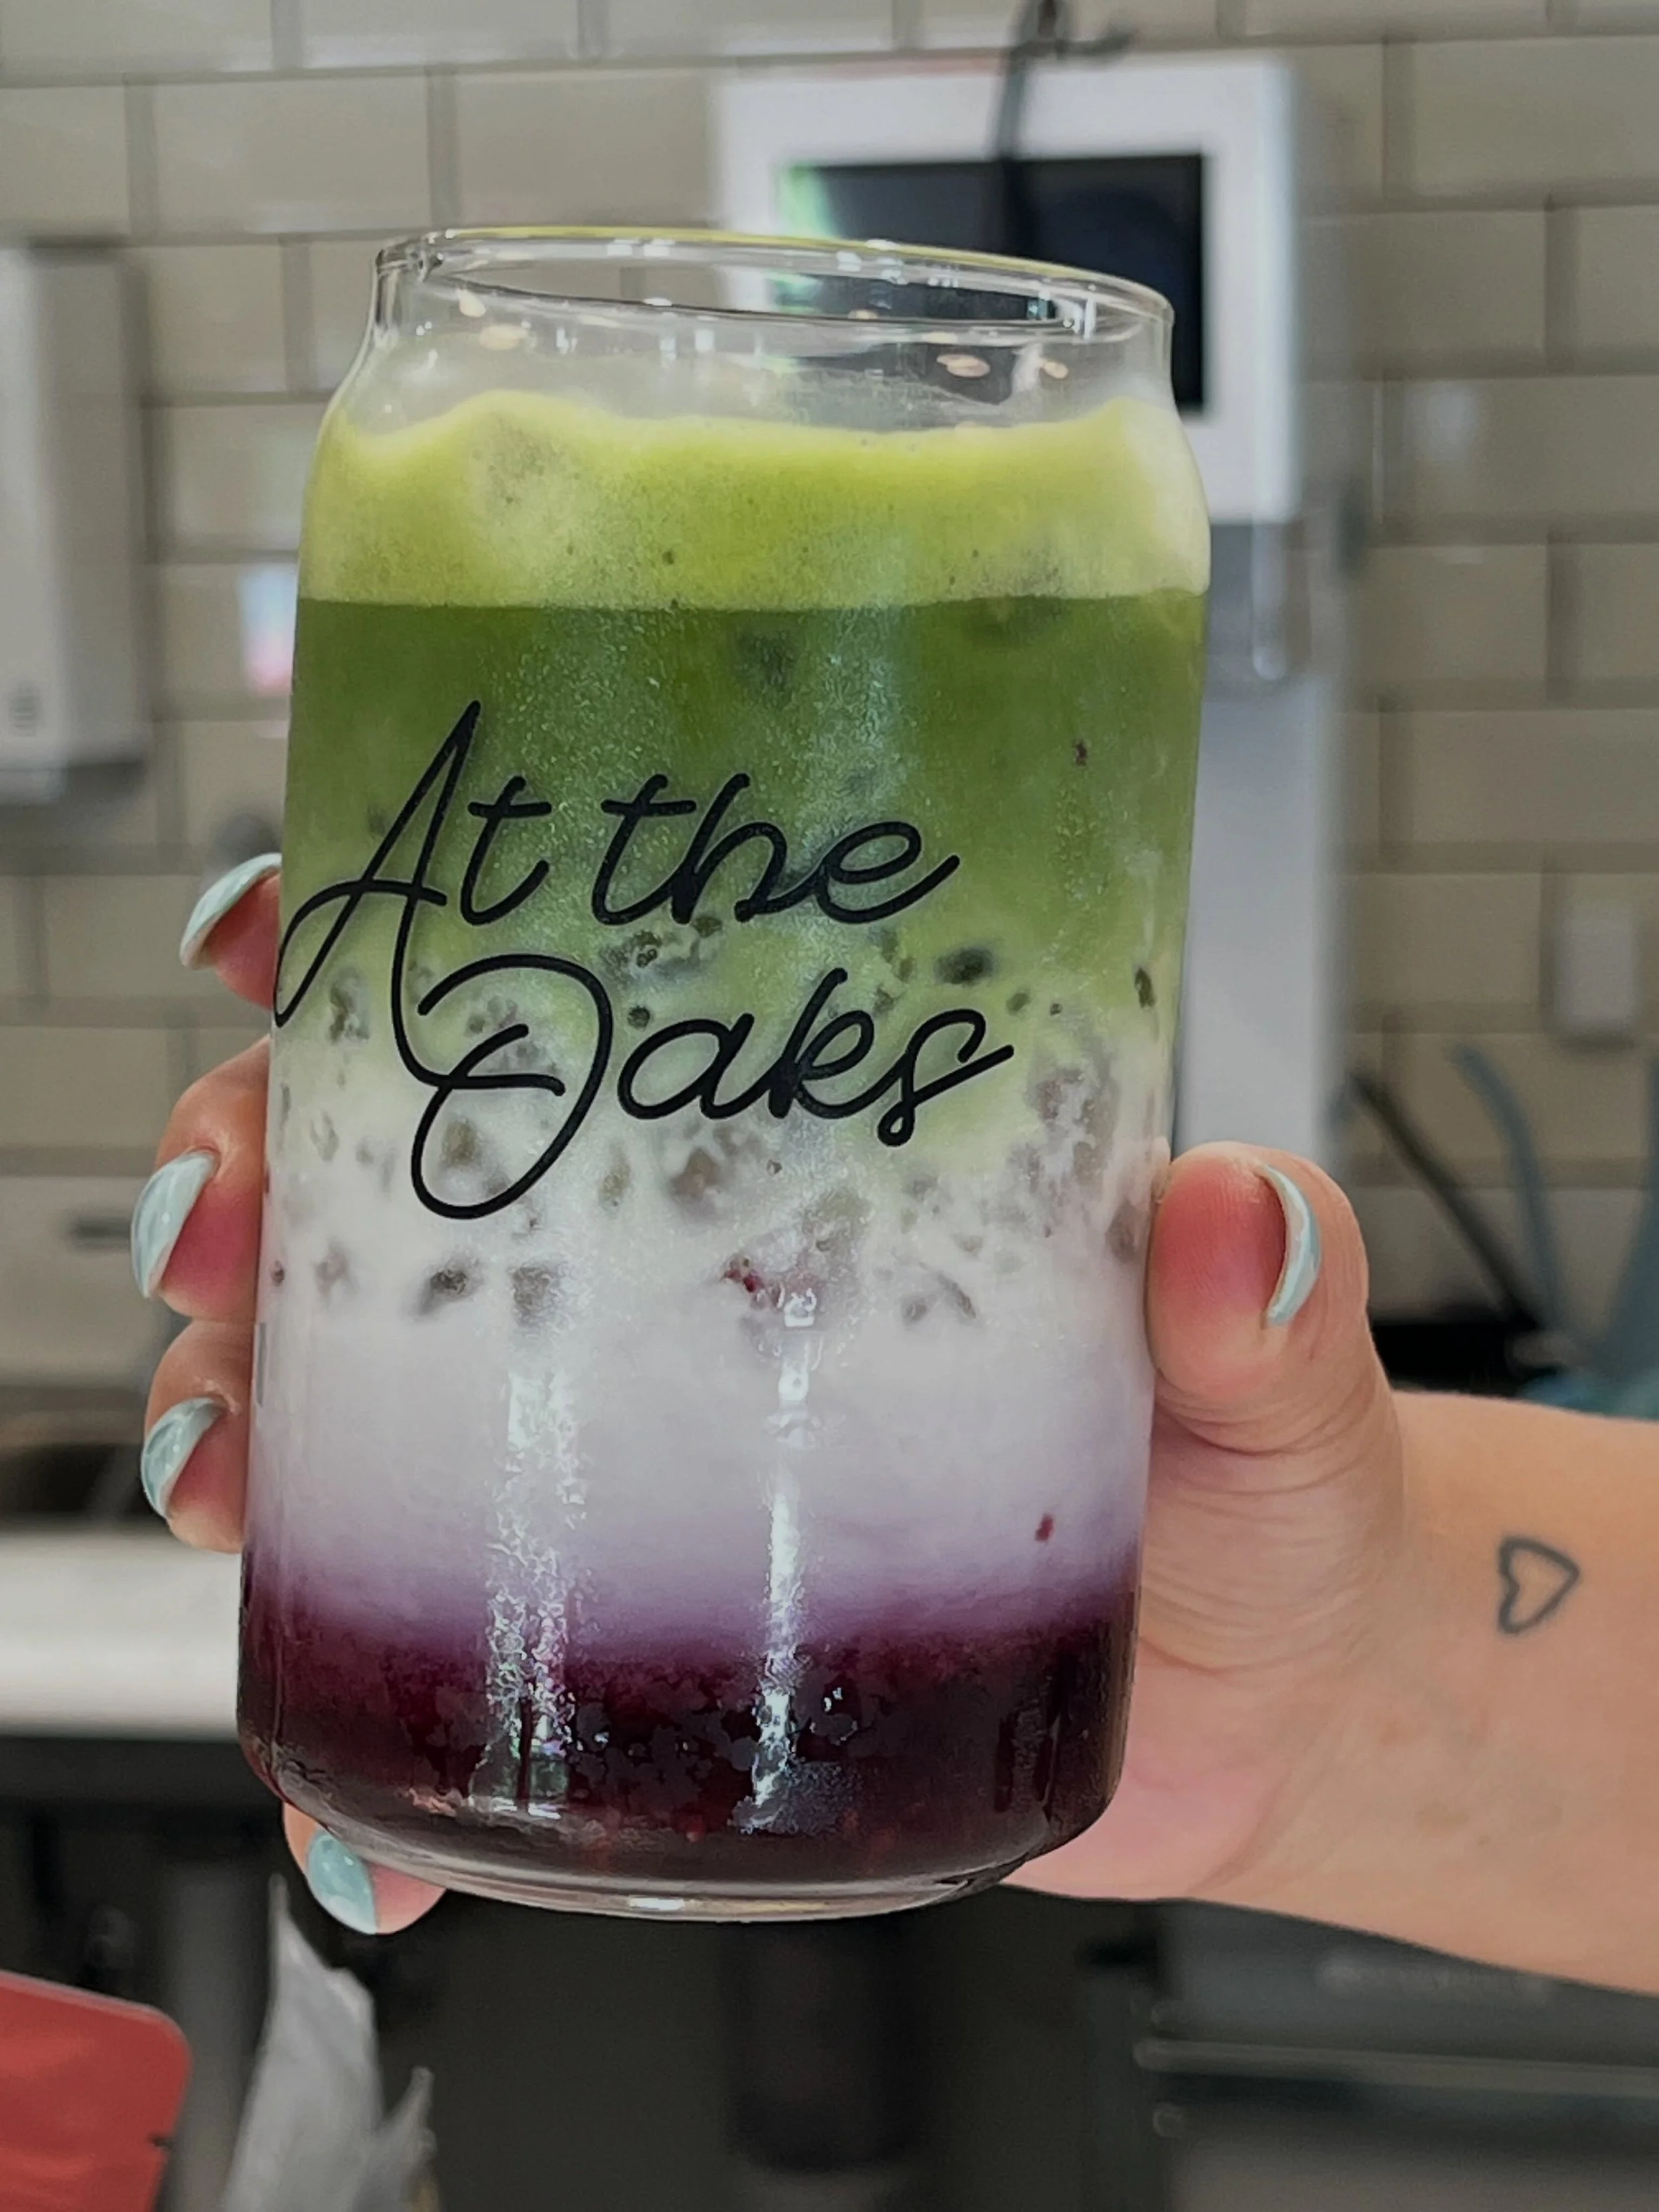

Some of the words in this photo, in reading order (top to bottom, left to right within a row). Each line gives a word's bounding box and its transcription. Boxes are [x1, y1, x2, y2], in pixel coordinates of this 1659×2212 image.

[273, 700, 565, 1096] At
[591, 773, 961, 924] the
[411, 954, 1015, 1219] Oaks
